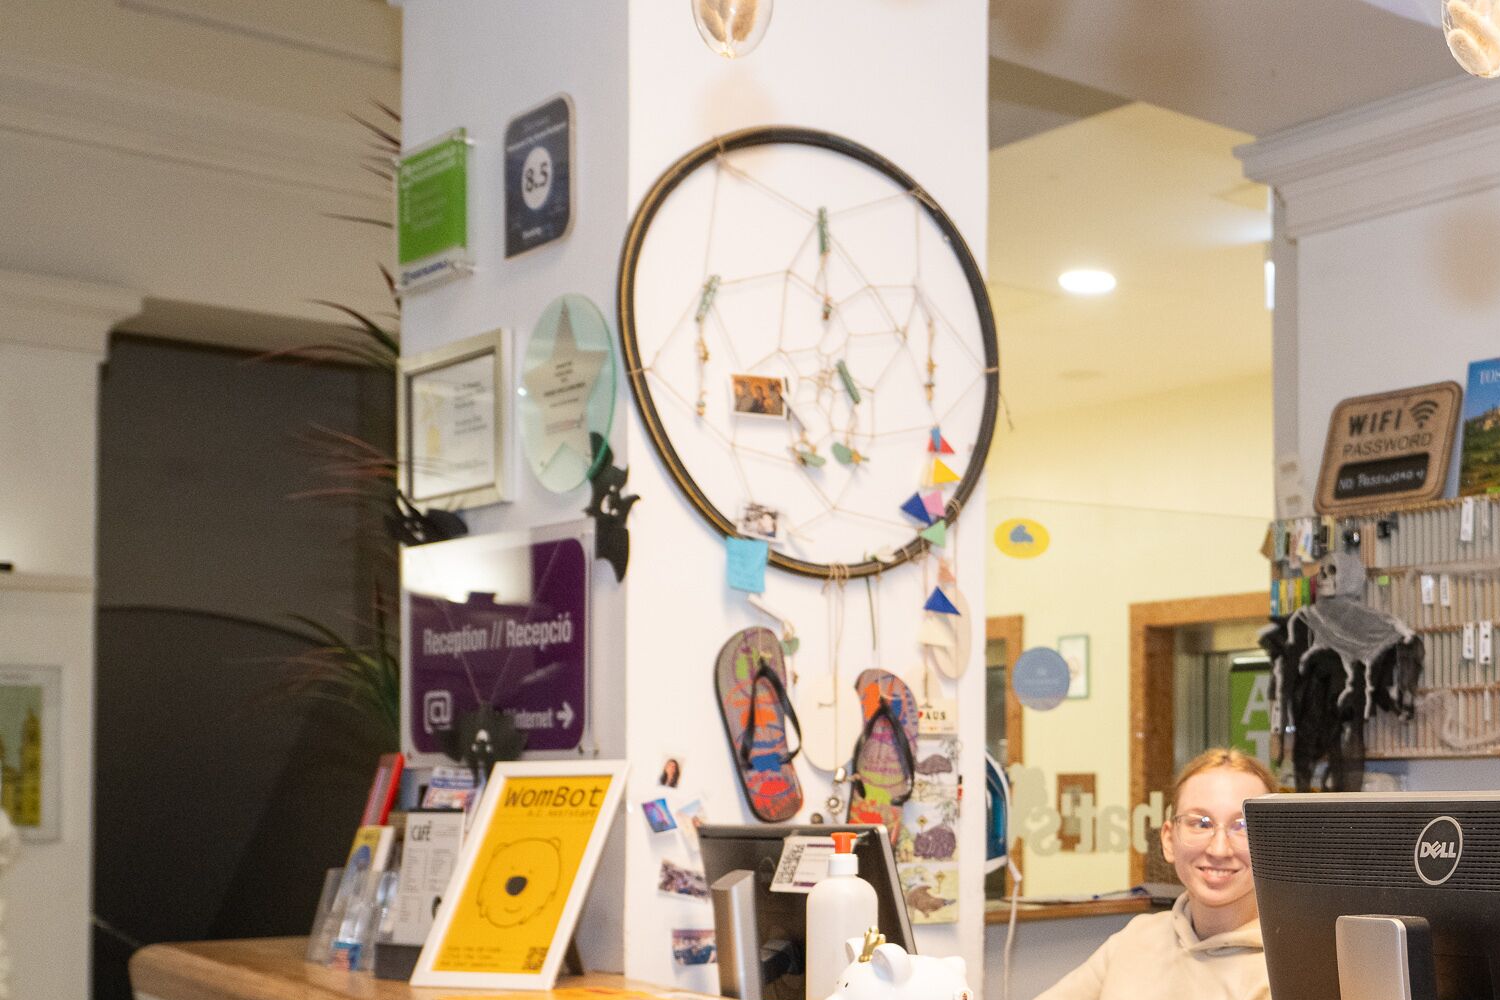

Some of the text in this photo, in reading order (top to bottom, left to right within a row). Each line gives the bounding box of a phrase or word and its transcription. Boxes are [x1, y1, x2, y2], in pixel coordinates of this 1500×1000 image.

[1349, 408, 1402, 437] WIFI
[1342, 432, 1432, 457] PASSWORD
[423, 625, 488, 660] Reception
[1420, 841, 1456, 859] DELL
